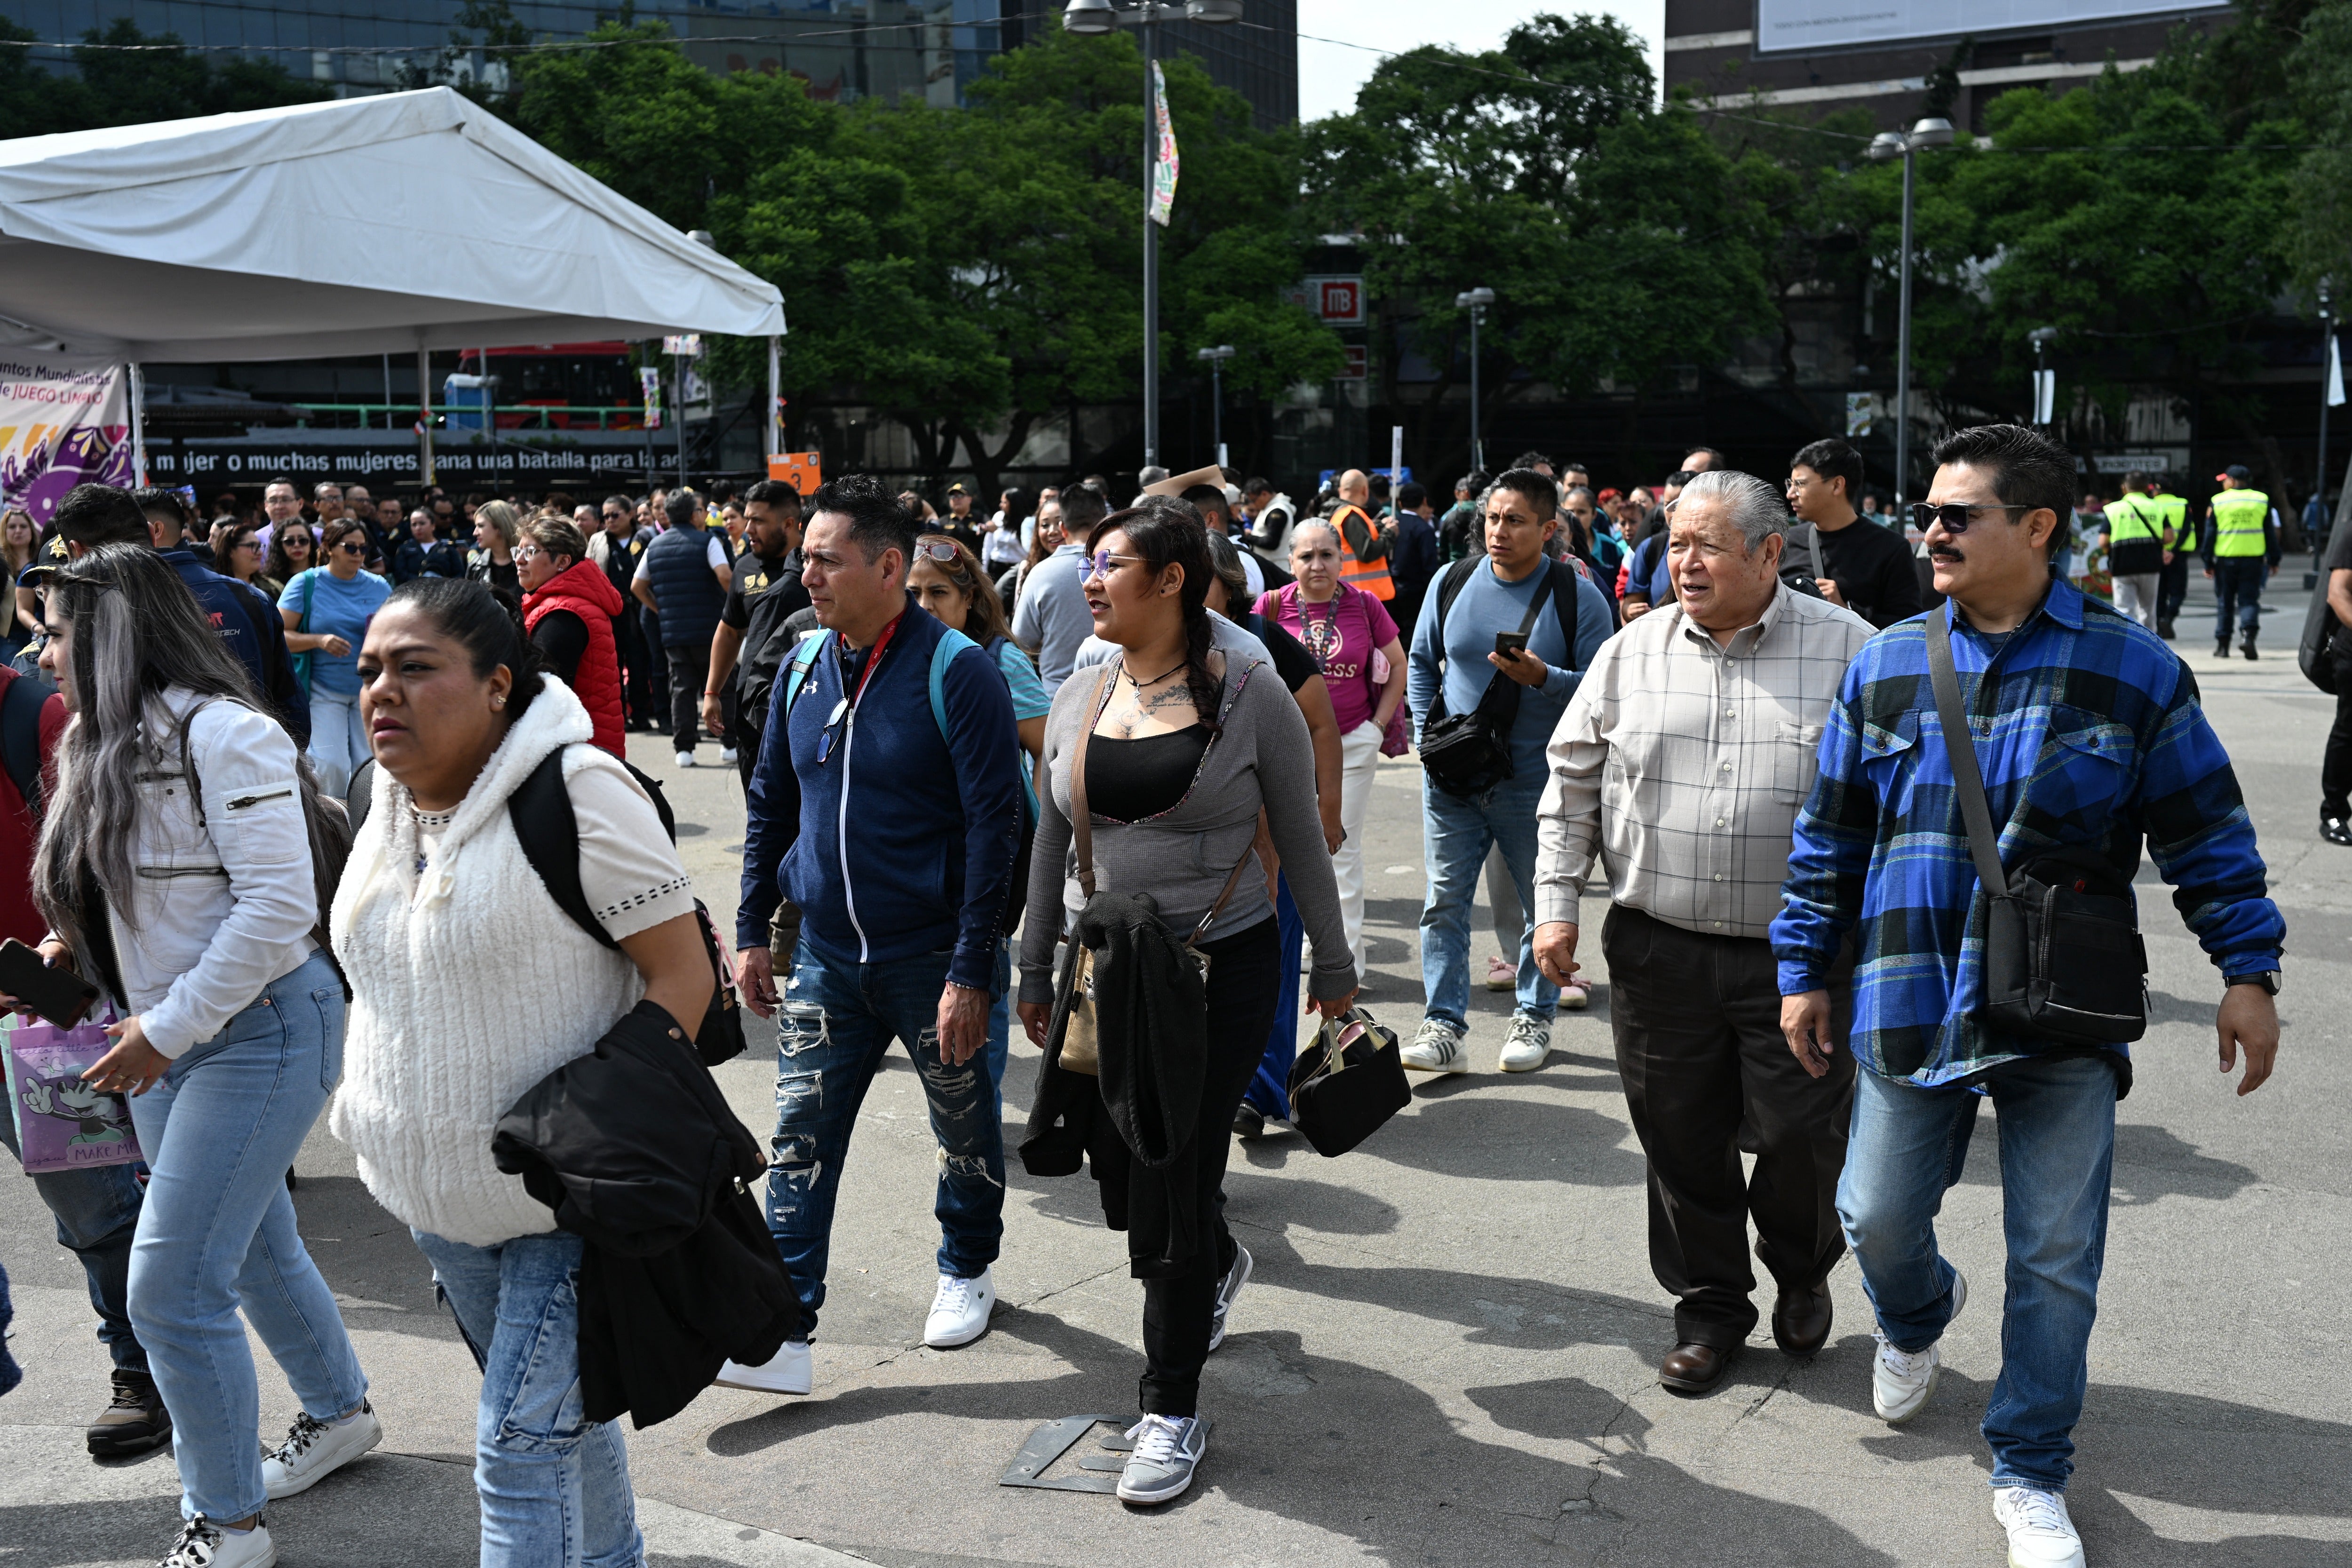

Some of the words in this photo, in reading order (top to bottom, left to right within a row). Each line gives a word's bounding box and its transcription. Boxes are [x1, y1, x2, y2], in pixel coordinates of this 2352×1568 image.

[12, 383, 56, 404] JUEGO
[227, 455, 241, 471] o
[248, 452, 329, 471] muchas
[436, 454, 472, 470] ana
[477, 454, 514, 470] una
[518, 451, 585, 470] batalla
[591, 453, 634, 472] para
[791, 473, 801, 493] 3
[1322, 663, 1357, 678] ESS
[17, 1045, 52, 1055] hello
[57, 1043, 89, 1053] little
[26, 1155, 66, 1166] you
[75, 1146, 112, 1161] MAKE
[118, 1141, 137, 1154] ME
